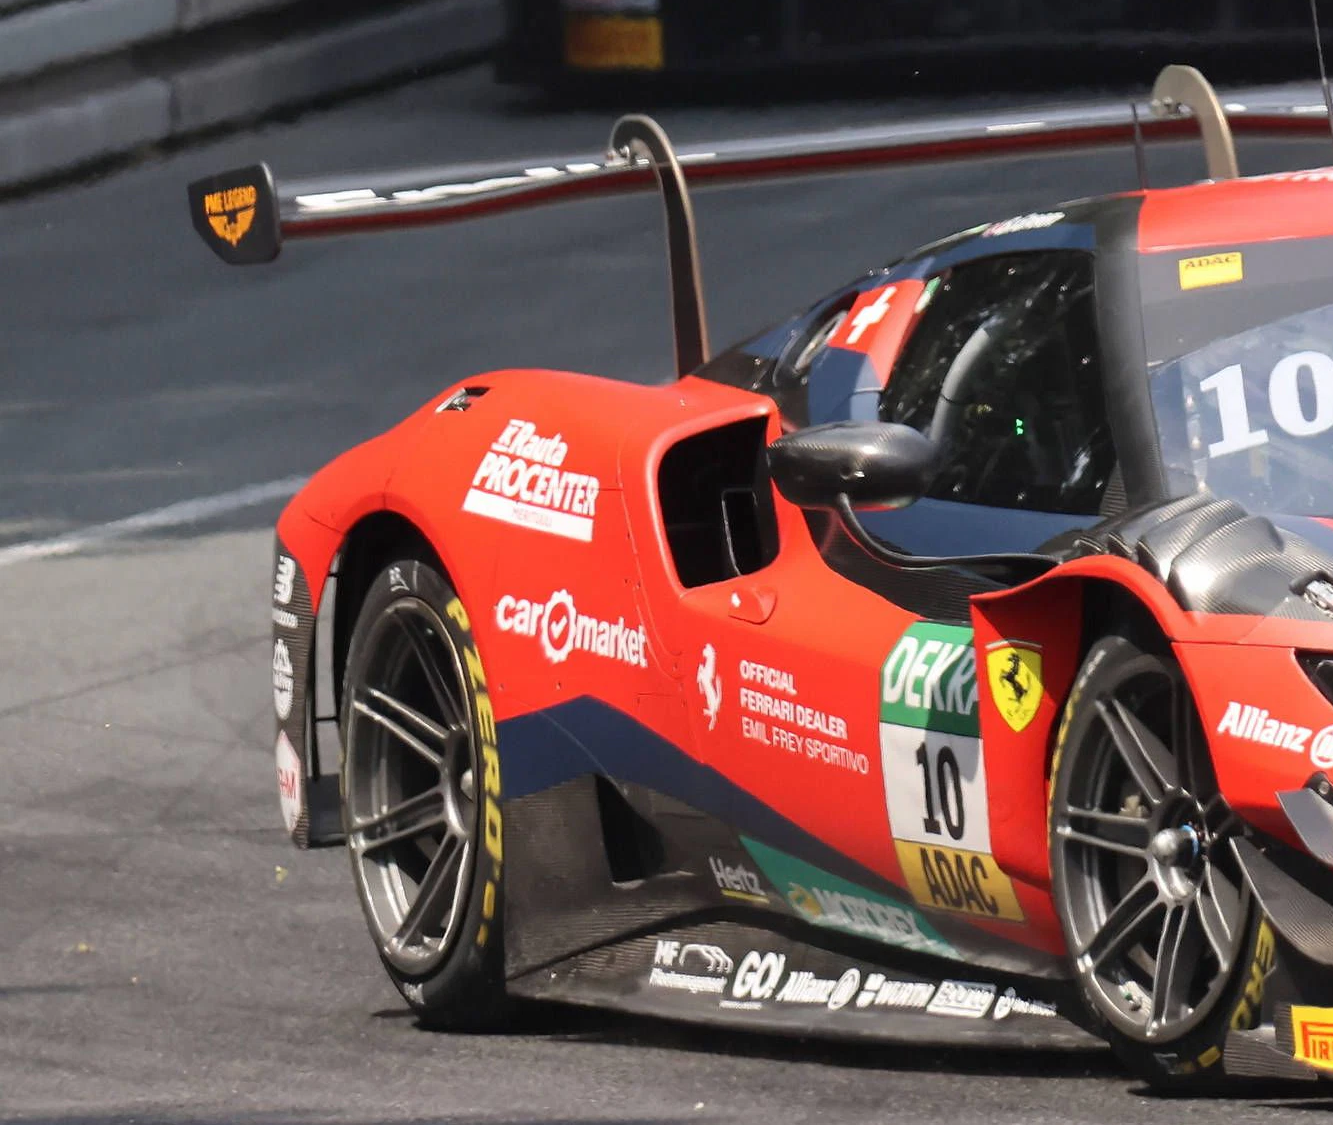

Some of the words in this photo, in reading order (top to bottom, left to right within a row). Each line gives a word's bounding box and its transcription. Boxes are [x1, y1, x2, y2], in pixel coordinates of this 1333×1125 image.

[205, 190, 221, 215] PME
[222, 184, 257, 211] LEGEND
[1184, 253, 1238, 272] ADAC
[472, 450, 600, 517] PROCENTER
[496, 594, 543, 636] car
[575, 614, 649, 669] market
[740, 660, 797, 695] OFFICIAL
[740, 689, 795, 724] FERRARI
[796, 705, 848, 741] DEALER
[1218, 700, 1314, 753] Allianz
[742, 716, 770, 746] EMIL
[771, 725, 805, 755] FREY
[805, 737, 870, 776] SPORTIVO
[915, 741, 965, 841] 10
[708, 856, 767, 897] Hertz
[920, 847, 999, 920] ADAC
[732, 950, 786, 999] GO!
[775, 971, 838, 1004] Allianz
